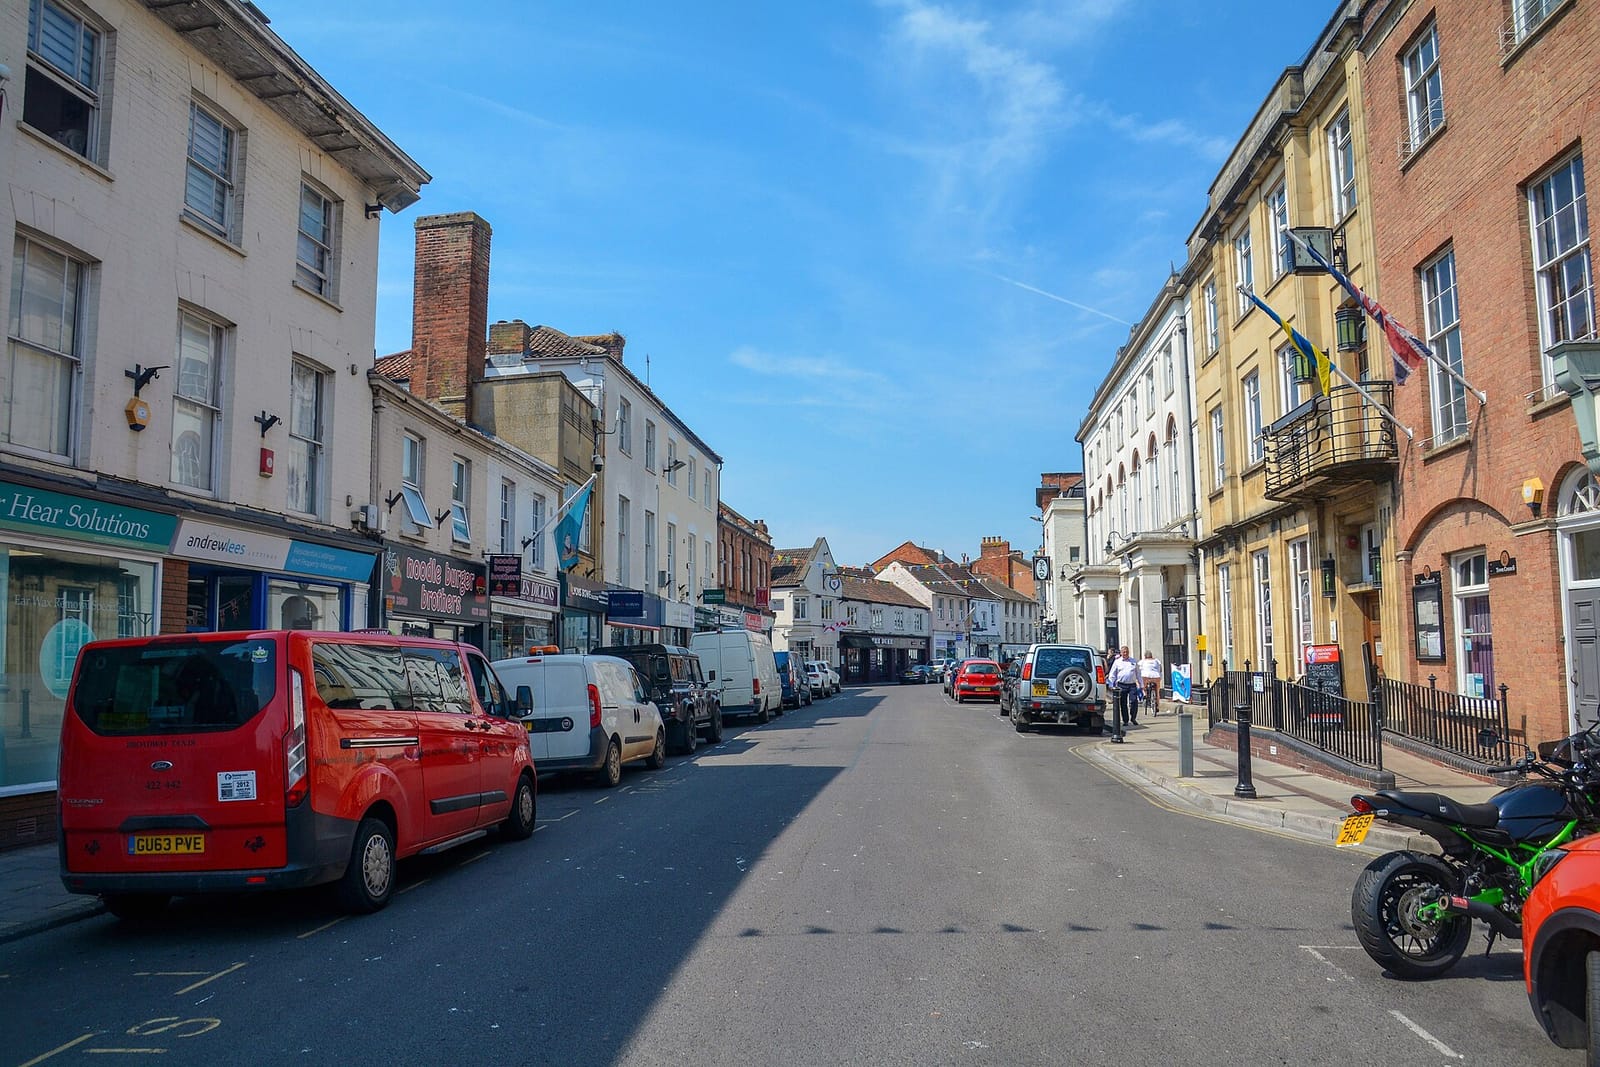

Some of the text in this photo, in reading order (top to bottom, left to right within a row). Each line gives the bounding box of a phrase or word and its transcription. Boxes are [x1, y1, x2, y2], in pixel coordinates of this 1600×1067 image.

[8, 493, 150, 538] Hear Solutions
[406, 556, 475, 596] noodle burger
[420, 584, 462, 614] brothers
[530, 582, 555, 600] DICKENS
[1344, 816, 1371, 830] EF69
[136, 837, 202, 852] GU63 PVE
[1341, 830, 1362, 842] ZHC
